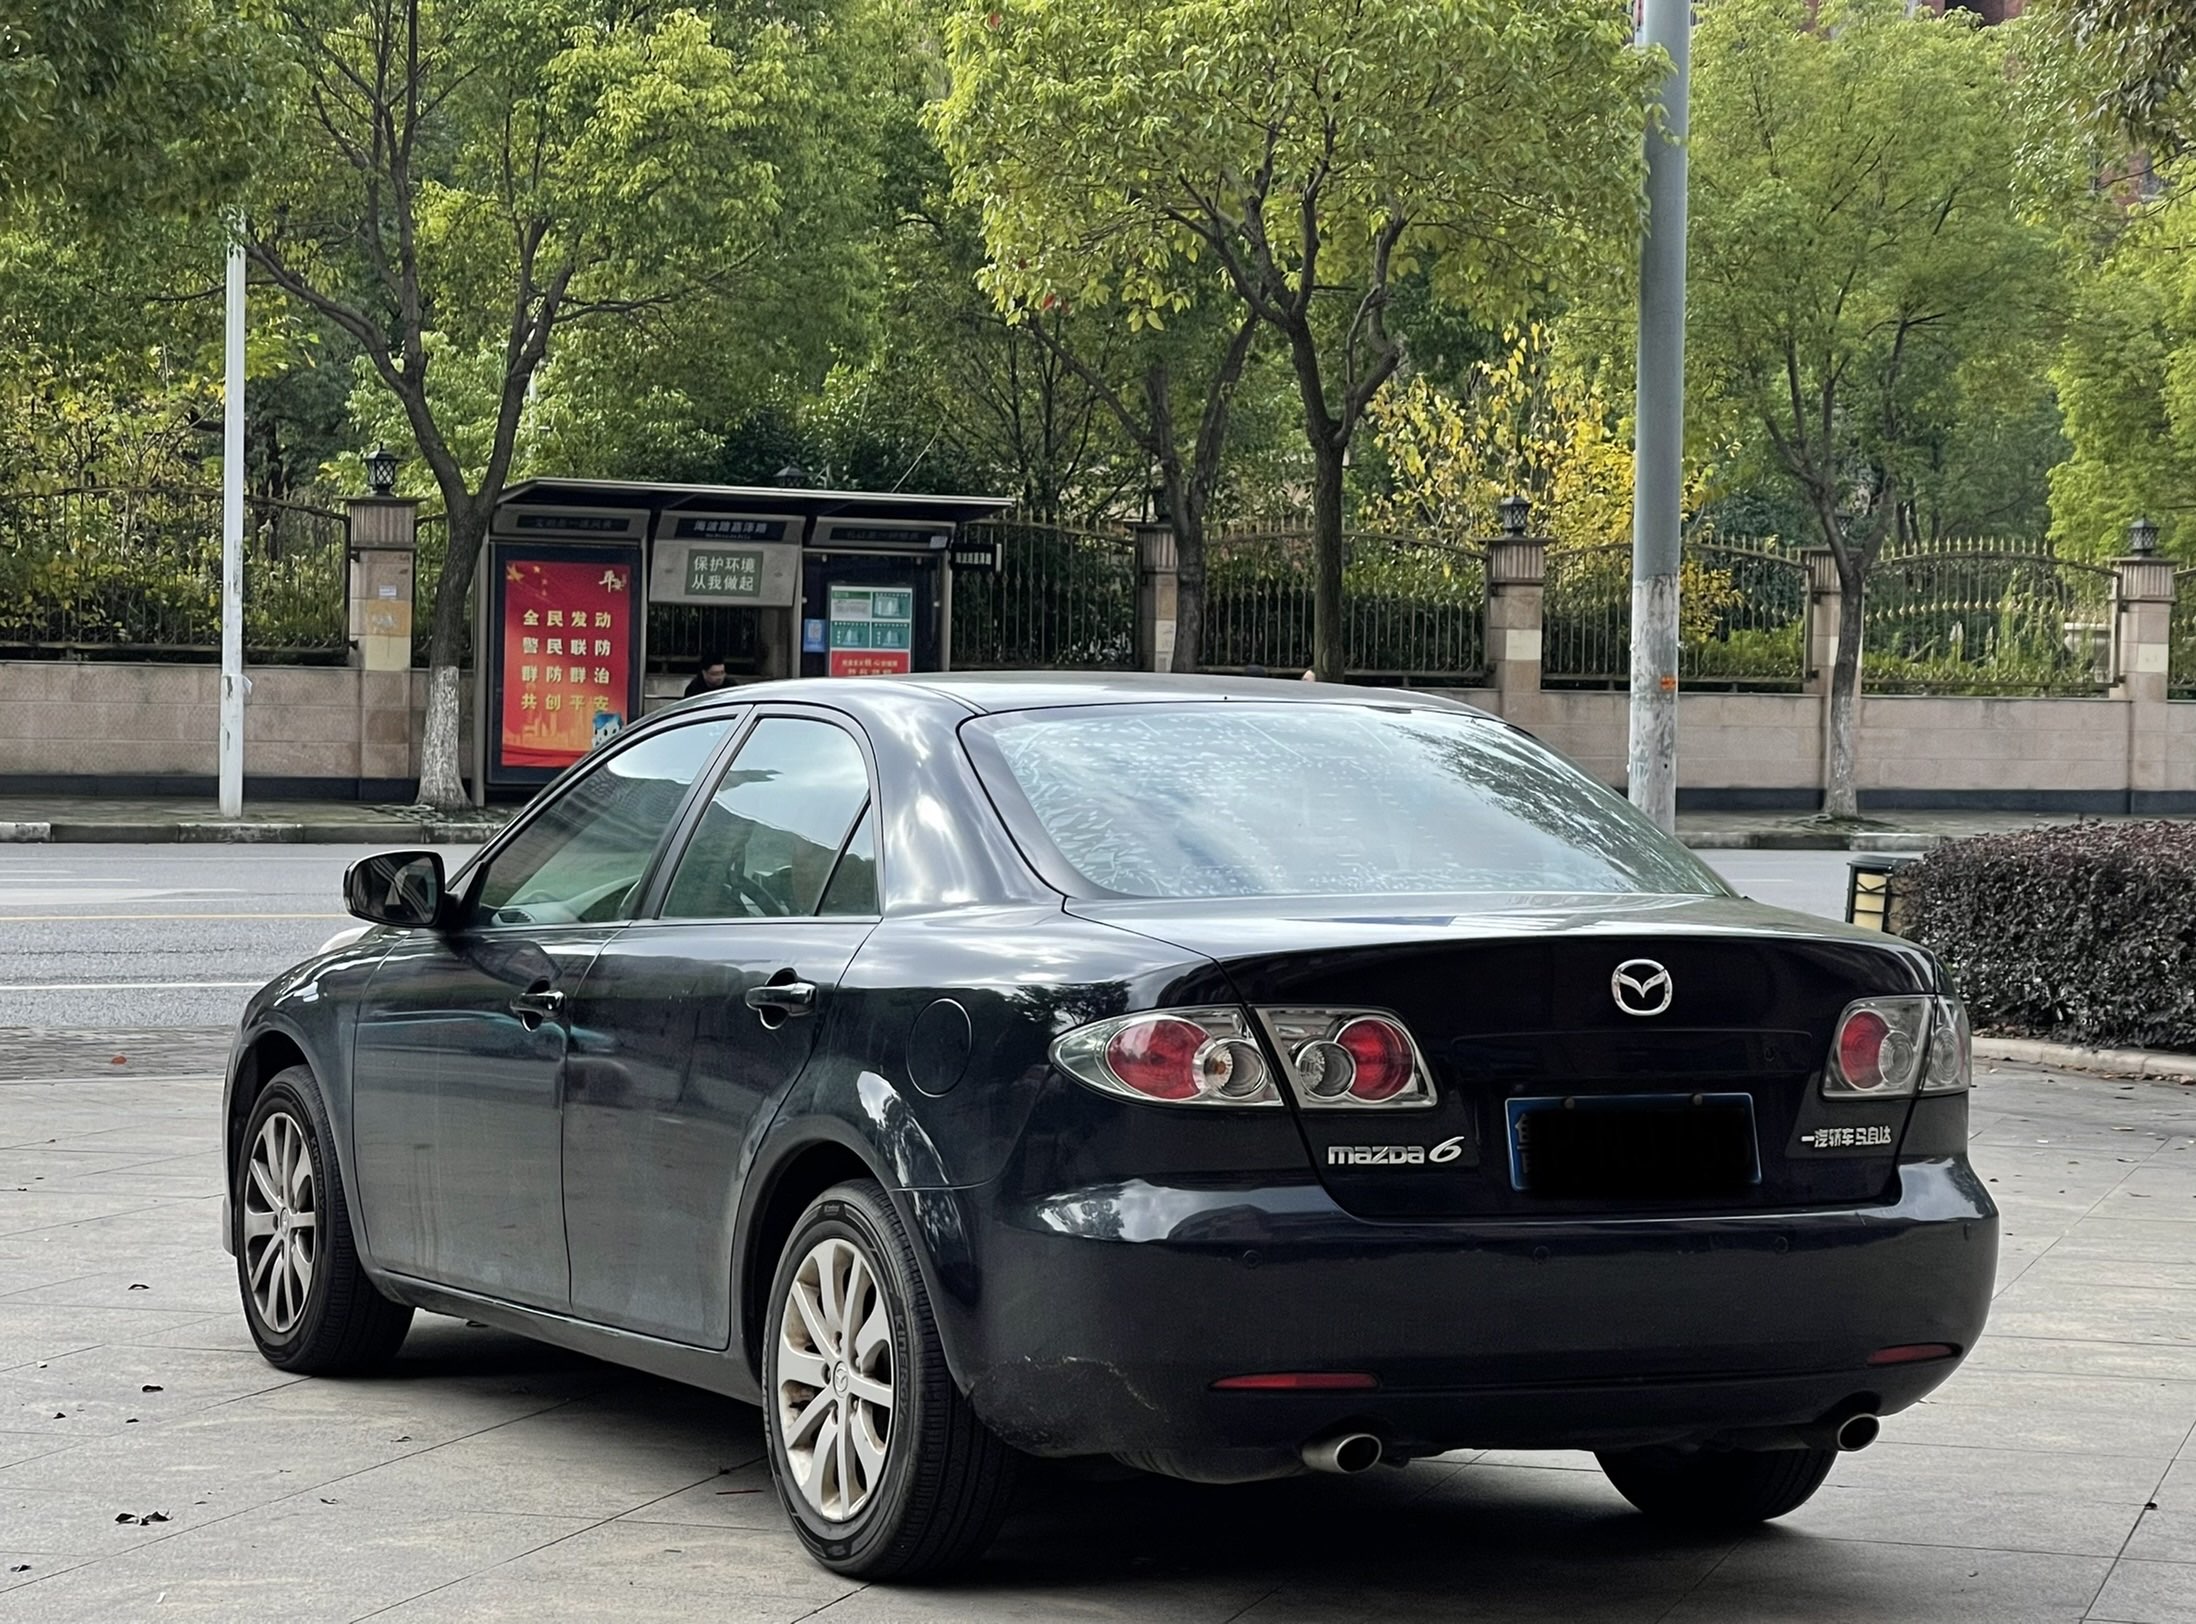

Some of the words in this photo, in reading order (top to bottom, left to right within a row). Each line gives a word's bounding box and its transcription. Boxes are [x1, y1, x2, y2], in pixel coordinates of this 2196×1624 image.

[694, 555, 755, 573] 保护环境
[691, 574, 754, 592] 从我做起
[523, 609, 612, 628] 全民发动
[522, 637, 611, 657] 警民联防
[521, 666, 610, 684] 群防群治
[521, 693, 609, 711] 共创平安
[1800, 1125, 1892, 1148] 一汽轿车马自达
[1428, 1135, 1465, 1163] 6
